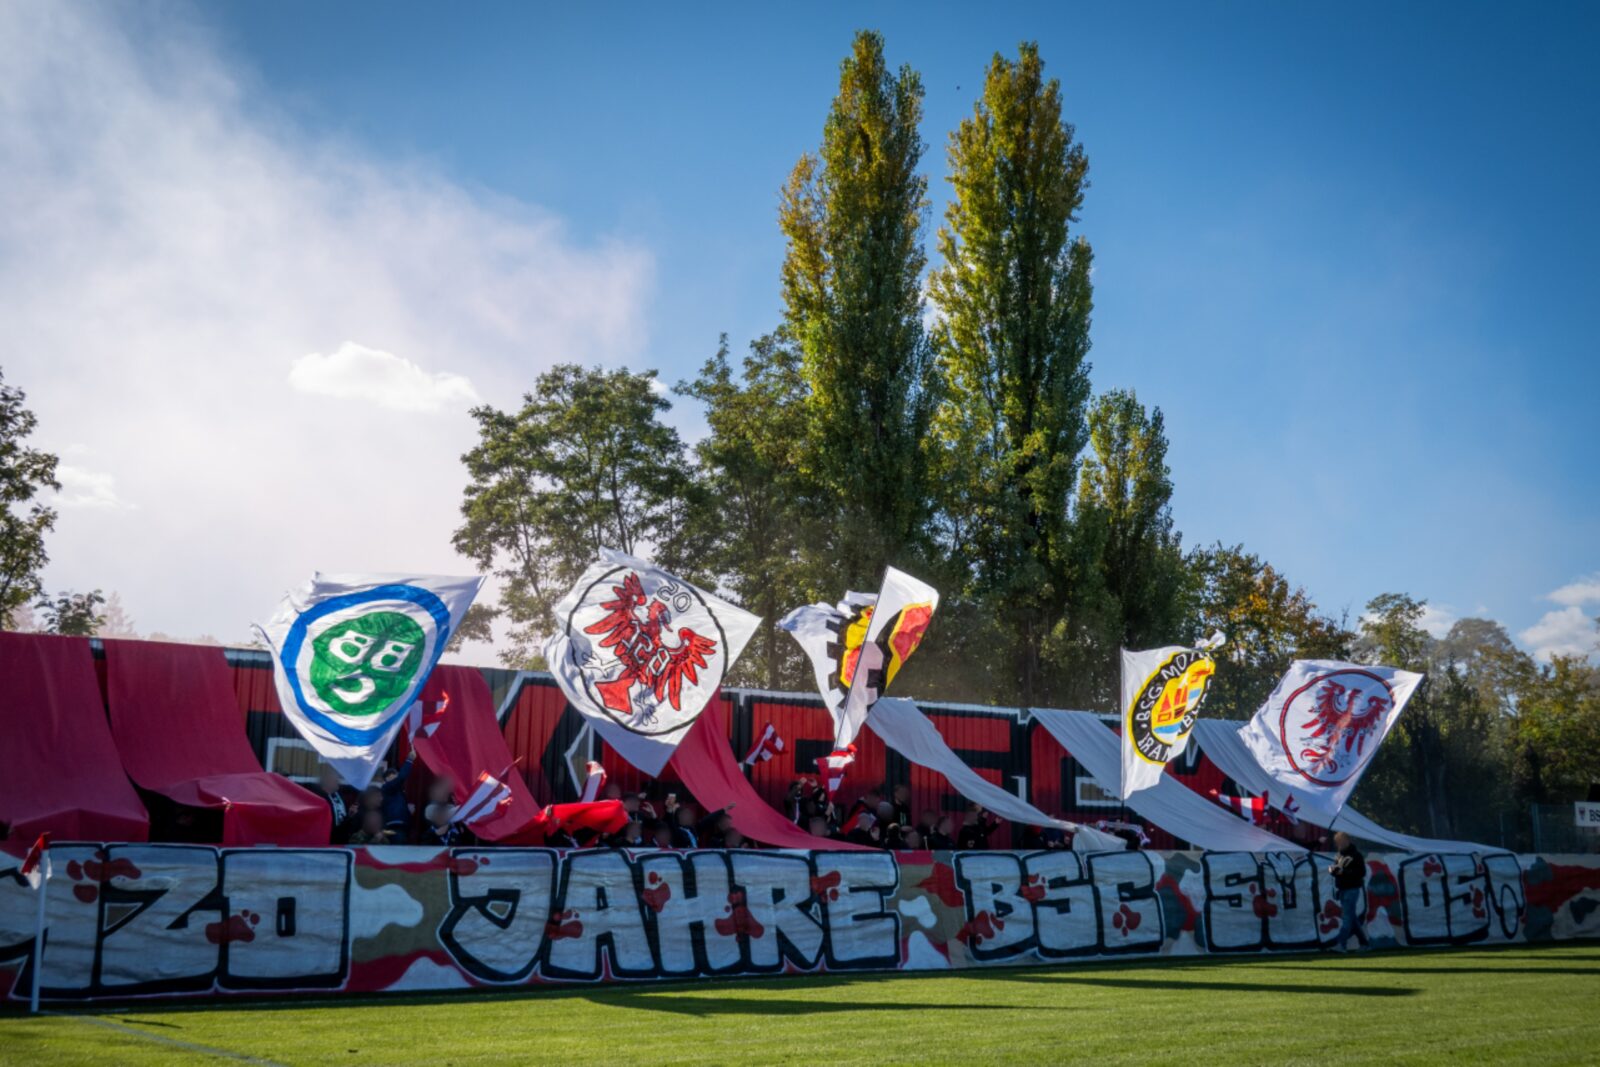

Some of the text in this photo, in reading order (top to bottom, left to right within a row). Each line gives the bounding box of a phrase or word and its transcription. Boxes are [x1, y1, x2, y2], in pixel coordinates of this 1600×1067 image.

[1135, 685, 1164, 721] BSG
[438, 847, 900, 982] JAHRE
[952, 849, 1165, 962] BSC
